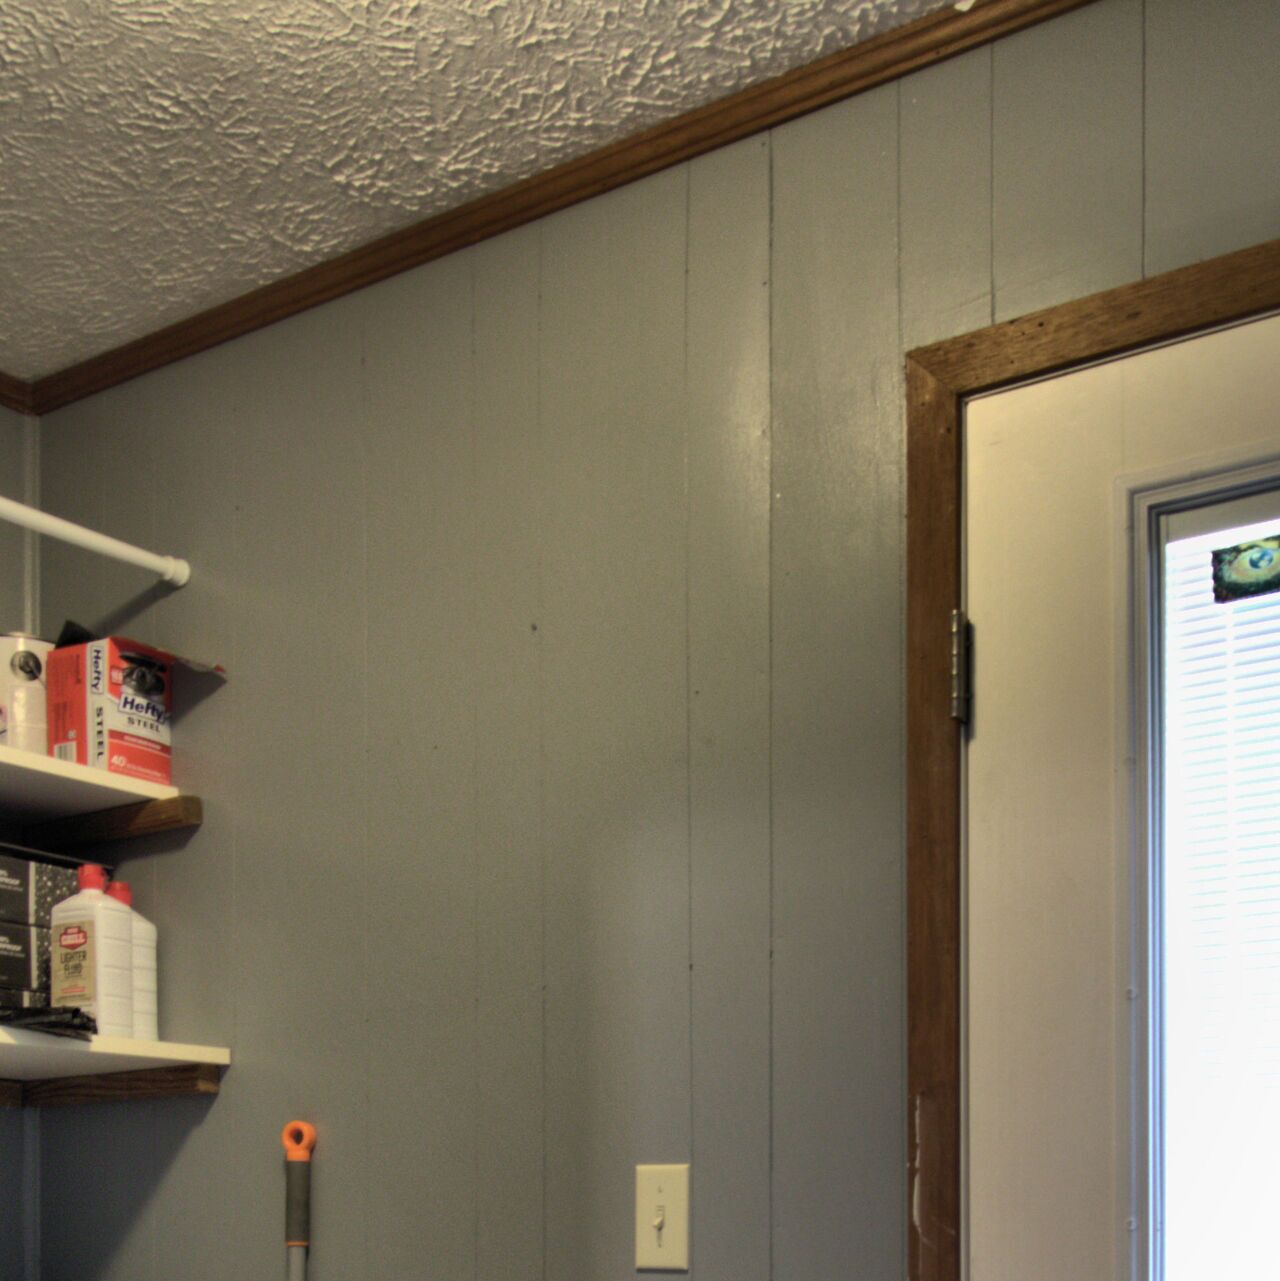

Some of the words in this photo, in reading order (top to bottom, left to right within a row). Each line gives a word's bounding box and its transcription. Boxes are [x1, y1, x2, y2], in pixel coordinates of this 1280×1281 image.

[91, 649, 102, 690] Hefty
[122, 696, 165, 723] Hefty
[127, 716, 161, 733] STEEL
[96, 706, 104, 760] STEEL
